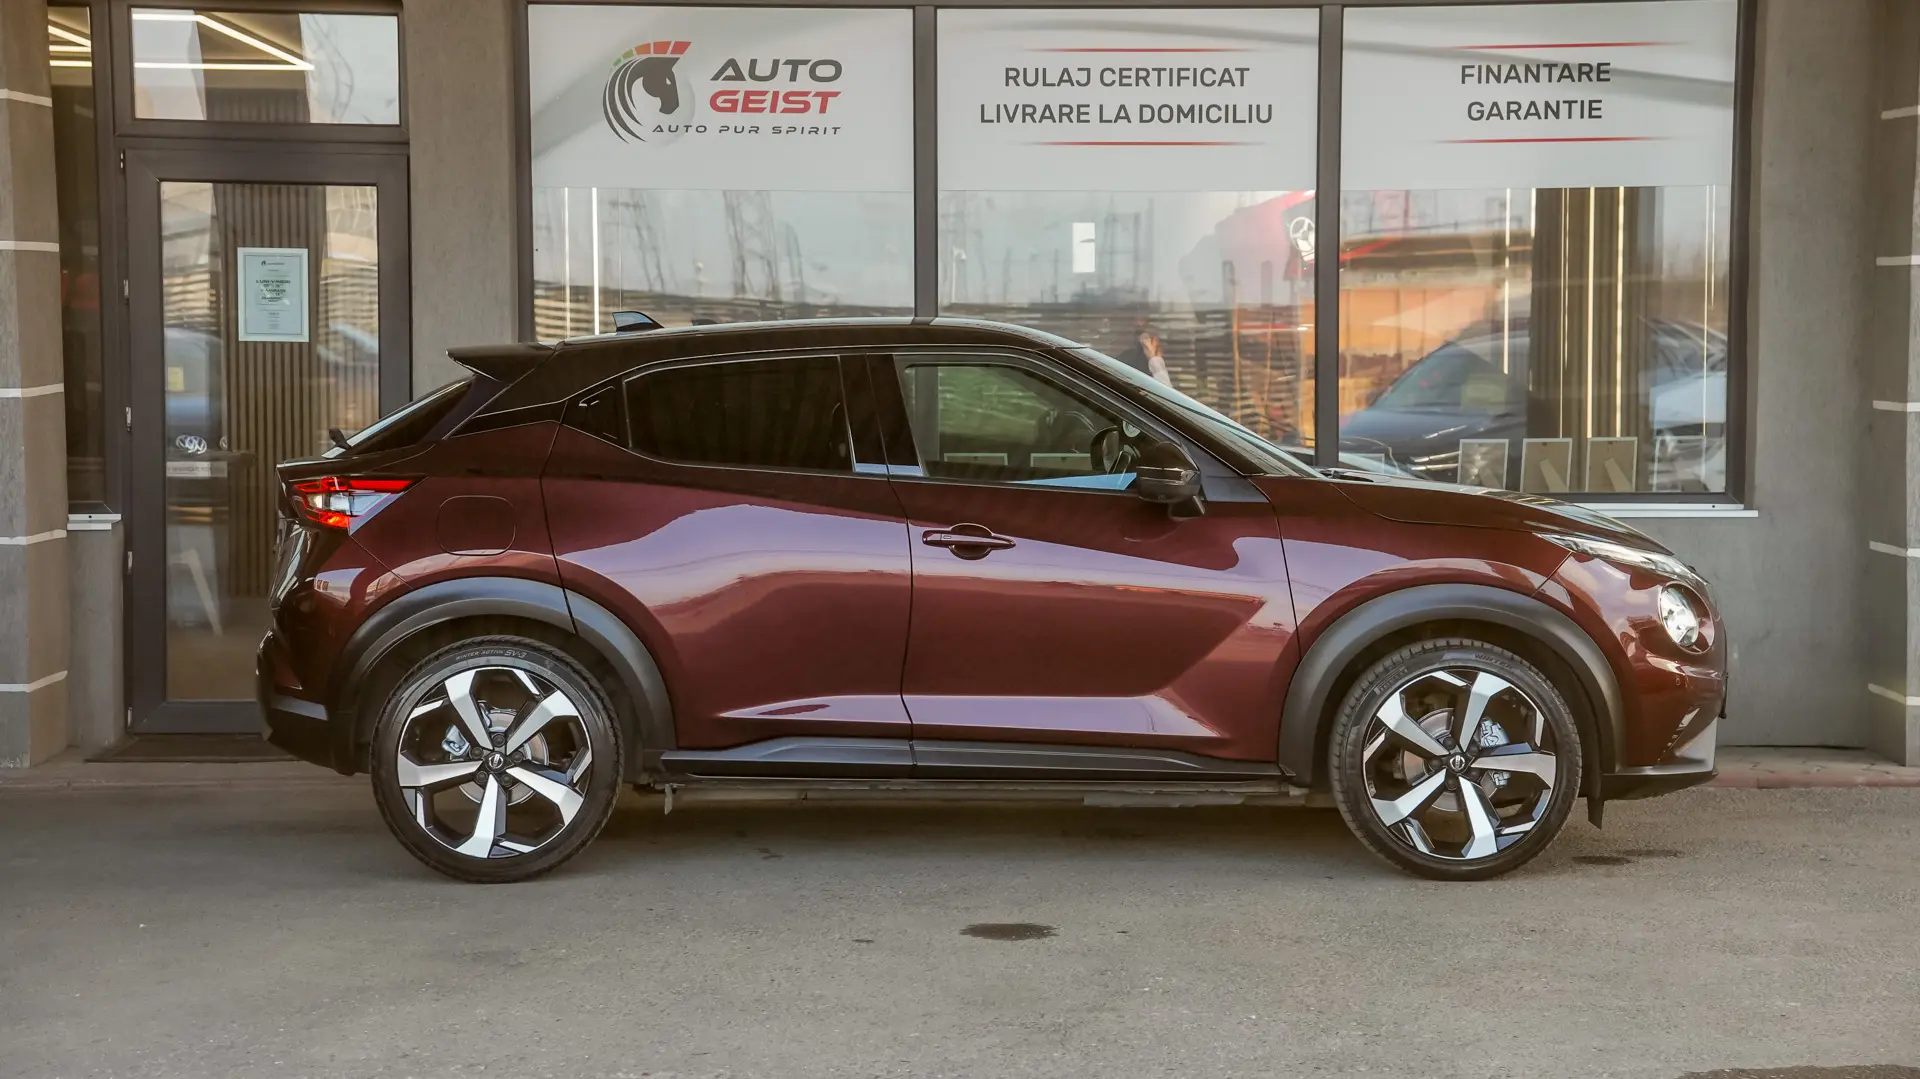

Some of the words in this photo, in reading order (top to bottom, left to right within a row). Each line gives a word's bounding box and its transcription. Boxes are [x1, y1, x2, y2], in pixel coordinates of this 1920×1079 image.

[709, 57, 843, 83] AUTO
[1004, 67, 1092, 87] RULAJ
[1099, 67, 1250, 87] CERTIFICAT
[1461, 62, 1611, 84] FINANTARE
[709, 89, 842, 114] GEIST
[1467, 99, 1603, 121] GARANTIE
[980, 103, 1091, 124] LIVRARE
[1099, 103, 1132, 124] LA
[1139, 103, 1273, 124] DOMICILIU
[652, 124, 707, 134] AUTO
[718, 125, 760, 135] PUR
[771, 126, 841, 136] SPIRIT
[455, 651, 480, 661] WINTER
